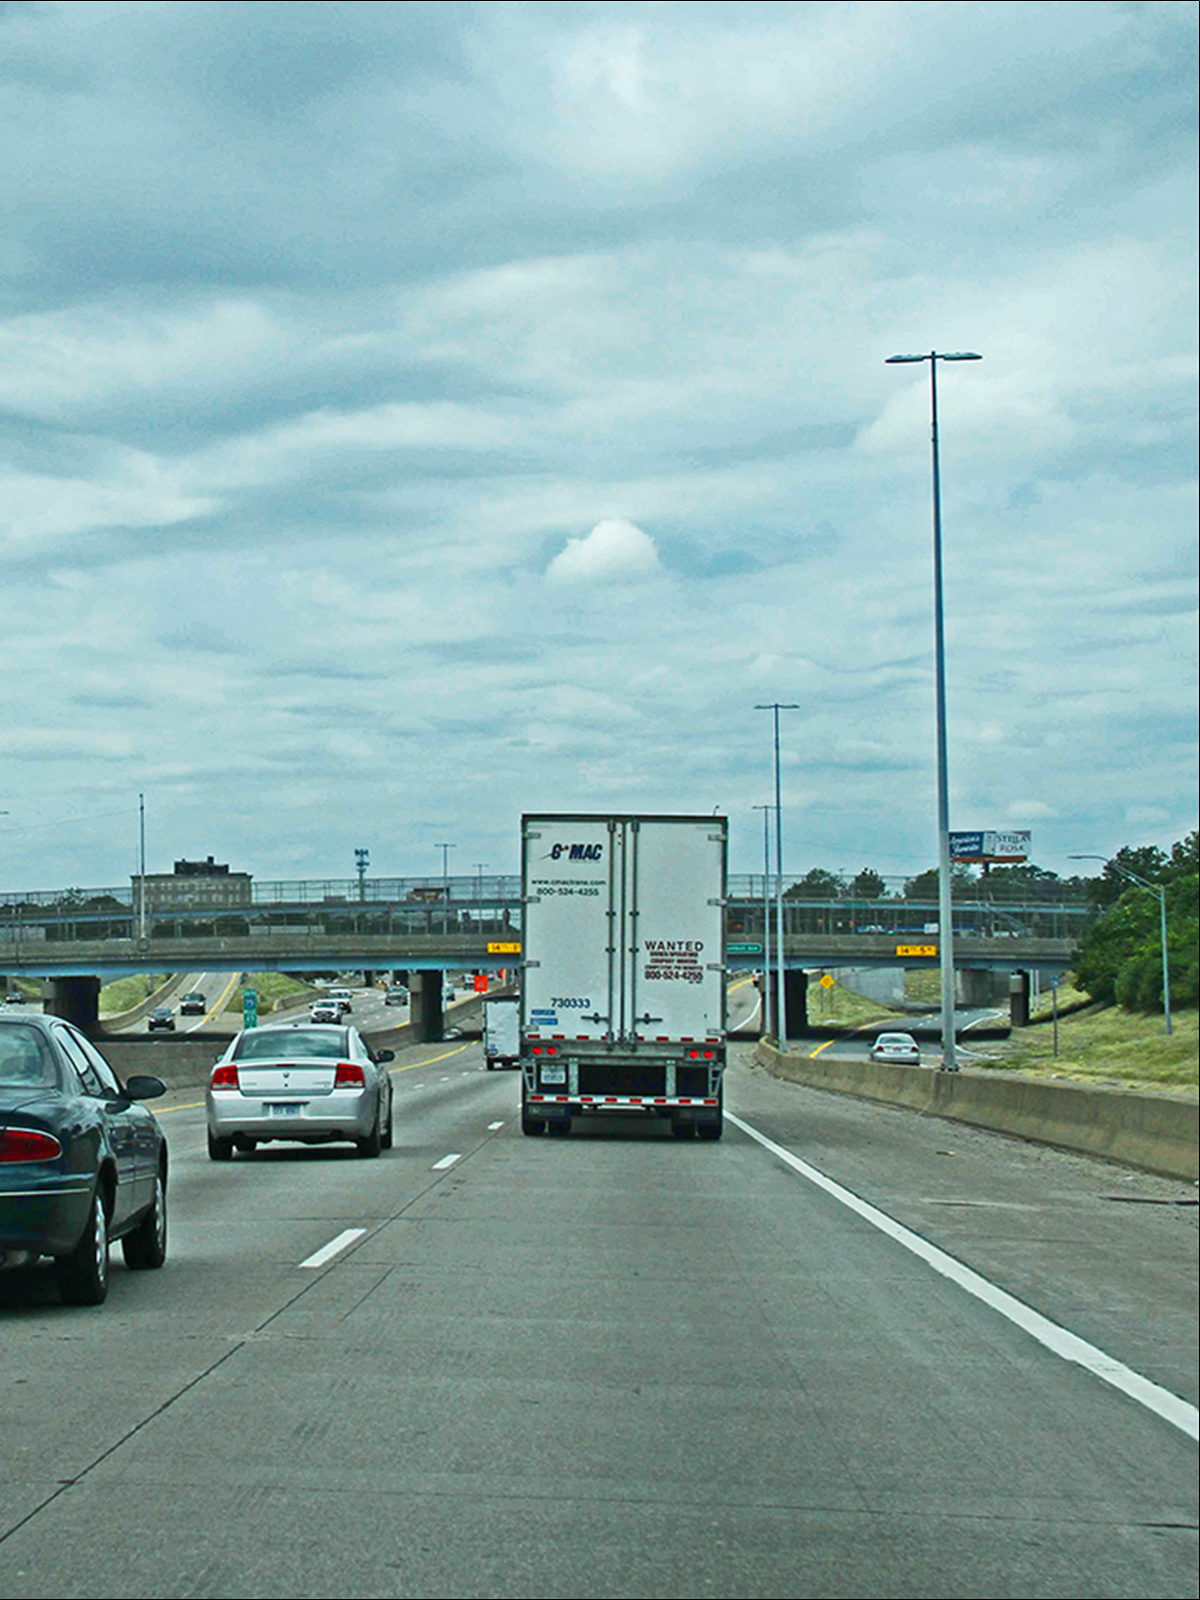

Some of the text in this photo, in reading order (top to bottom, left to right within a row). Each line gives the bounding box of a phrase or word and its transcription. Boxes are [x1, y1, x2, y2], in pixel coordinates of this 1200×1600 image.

[536, 887, 600, 896] 800-524-4255
[644, 940, 704, 952] WANTED
[644, 970, 703, 981] 800-524-4255
[550, 997, 591, 1009] 730333
